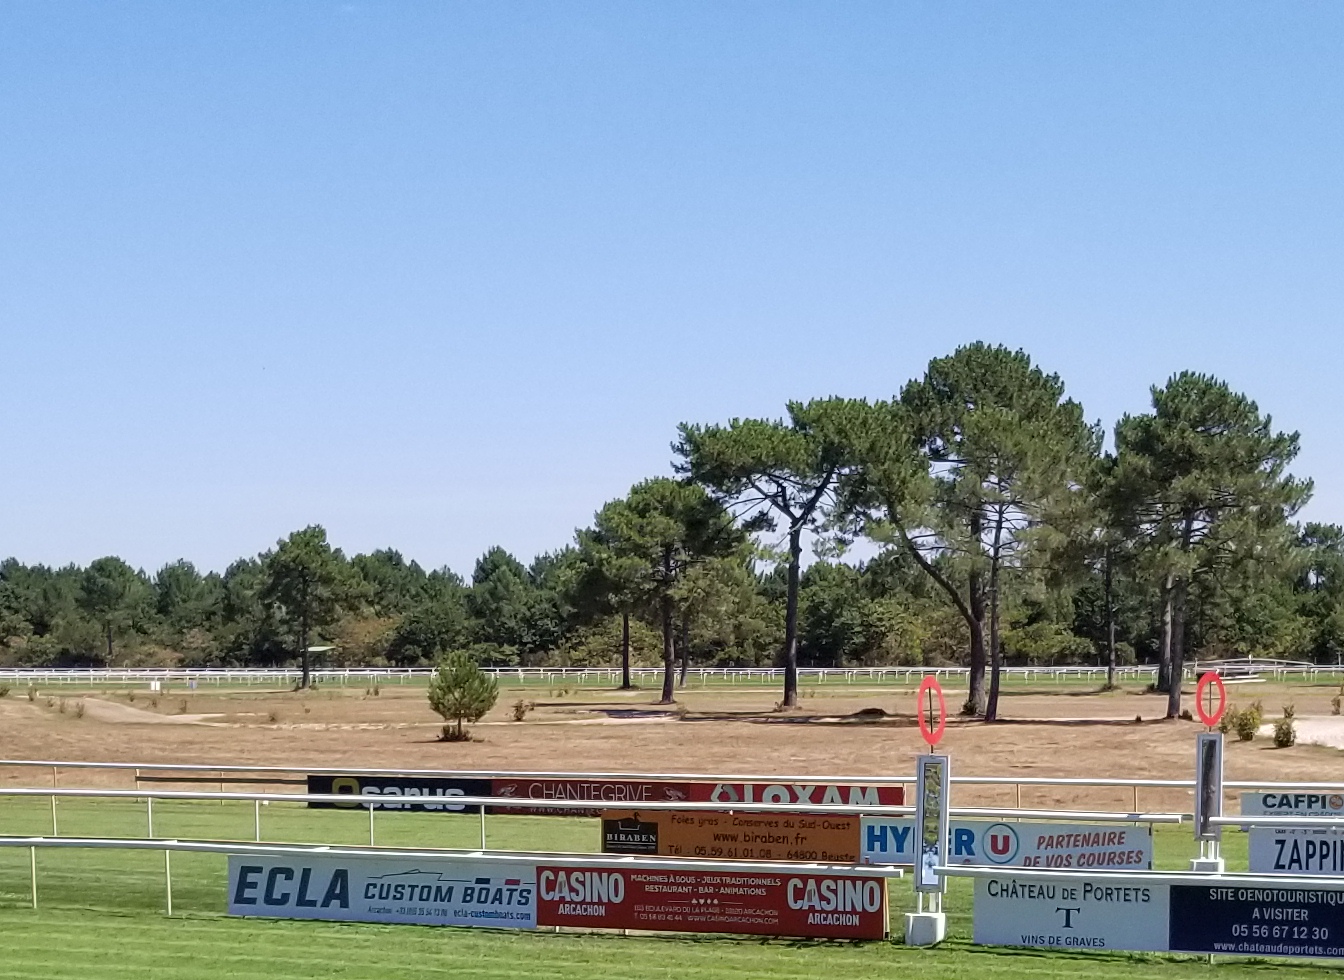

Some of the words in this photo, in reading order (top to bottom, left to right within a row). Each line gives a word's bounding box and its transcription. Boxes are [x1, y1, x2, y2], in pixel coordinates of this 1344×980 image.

[529, 783, 652, 801] CHANTEGRIVE
[1262, 794, 1327, 809] CAFPI
[671, 815, 694, 825] Foies
[698, 816, 719, 827] gras
[733, 818, 778, 829] Conserves
[783, 818, 795, 829] du
[799, 819, 851, 830] Sud-Ouest
[606, 833, 656, 842] BIRABEN
[713, 832, 807, 846] www.biraben.fr
[867, 825, 975, 856] HYR
[991, 834, 1010, 855] U
[1037, 831, 1126, 850] PARTENAIRE
[787, 849, 817, 860] 64800
[1024, 855, 1042, 867] DE
[1046, 853, 1072, 867] VOS
[1076, 850, 1144, 867] COURSES
[233, 865, 350, 909] ECLA
[539, 870, 625, 904] CASINO
[630, 874, 669, 883] MACHINES
[669, 874, 676, 883] À
[675, 876, 696, 884] SOUS
[701, 876, 722, 884] JEUX
[722, 876, 782, 887] TRADITIONNELS
[364, 882, 455, 903] CUSTOM
[461, 884, 533, 906] BOATS
[645, 884, 693, 894] RESTAURANT
[698, 885, 714, 894] BAR
[719, 886, 767, 896] ANIMATIONS
[787, 877, 882, 914] CASINO
[987, 879, 1056, 901] CHÂTEAU
[1082, 883, 1151, 903] PORTETS
[1209, 888, 1236, 901] SITE
[557, 903, 606, 917] ARCACHON
[743, 908, 779, 916] ARCACHON
[1252, 907, 1261, 920] A
[1263, 907, 1309, 921] VISITER
[807, 912, 860, 927] ARCACHON
[1231, 924, 1249, 937] 05
[1252, 925, 1269, 938] 56
[1272, 926, 1289, 938] 67
[1292, 926, 1308, 939] 12
[1311, 927, 1329, 940] 30
[1021, 934, 1045, 945] VINS
[1048, 935, 1062, 946] DE
[1064, 936, 1106, 948] GRAVES
